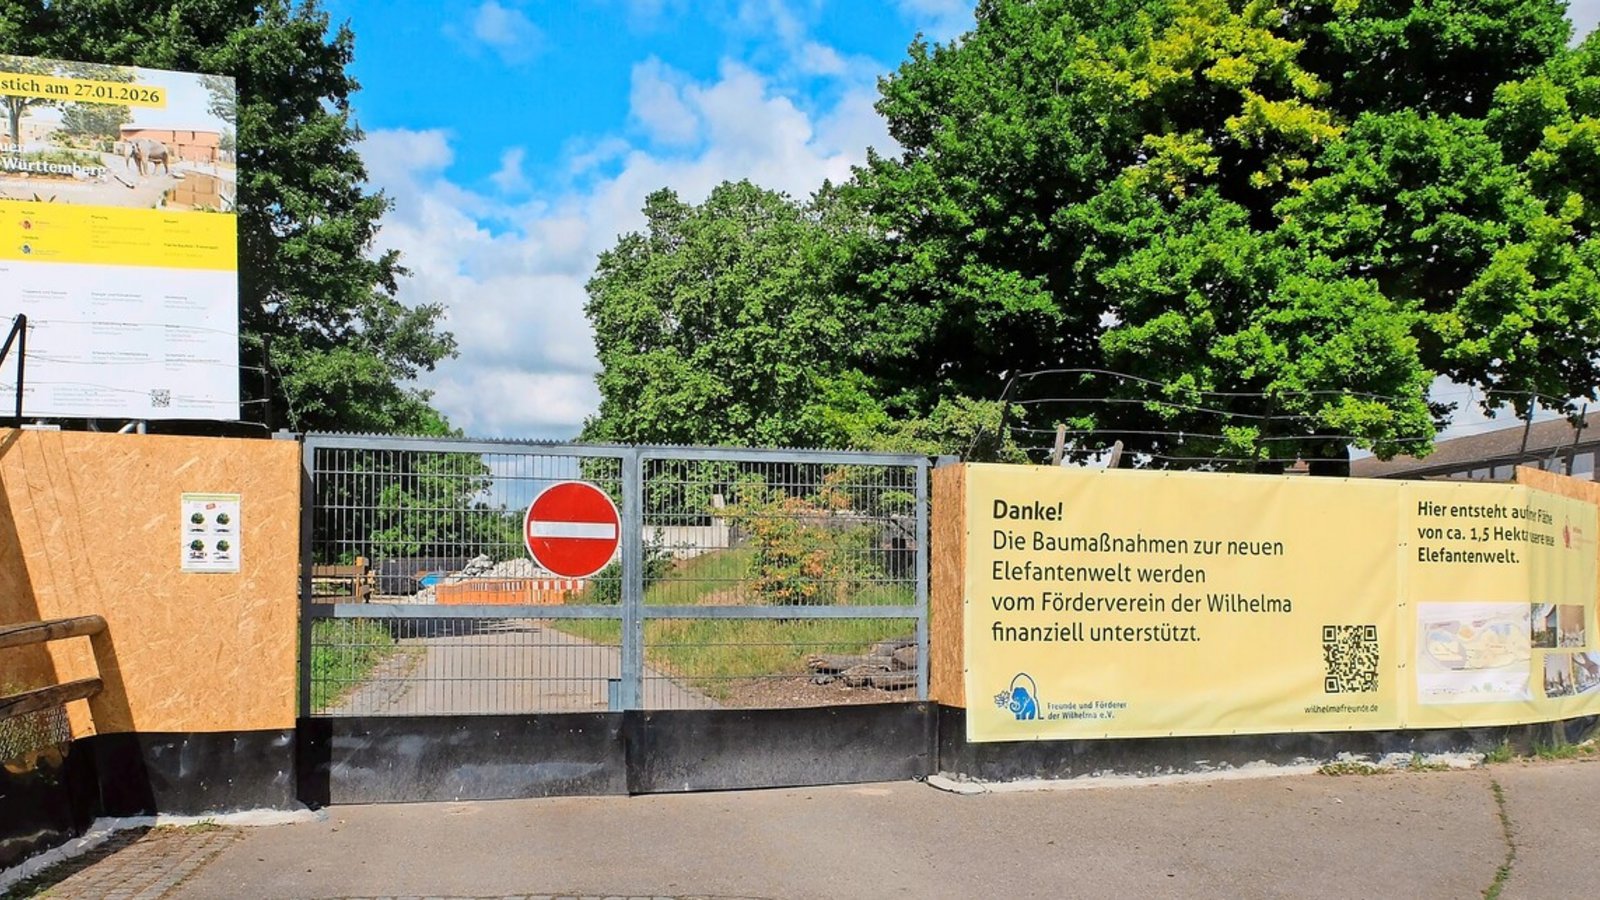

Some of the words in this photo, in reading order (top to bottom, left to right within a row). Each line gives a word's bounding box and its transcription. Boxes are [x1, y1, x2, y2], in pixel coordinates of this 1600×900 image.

[1, 78, 40, 92] stich
[45, 83, 69, 95] am
[74, 83, 160, 103] 27.01.2026
[993, 499, 1063, 521] Danke!
[1418, 500, 1448, 517] Hier
[1450, 503, 1508, 519] entsteht
[993, 530, 1026, 550] Die
[1033, 532, 1188, 554] Baumaßnahmen
[1193, 539, 1223, 555] zur
[1227, 540, 1285, 556] neuen
[1417, 527, 1443, 540] von
[1446, 528, 1466, 541] ca.
[1470, 527, 1490, 543] 1,5
[1418, 546, 1520, 564] Elefantenwelt.
[992, 561, 1132, 583] Elefantenwelt
[1137, 564, 1206, 584] werden
[991, 595, 1036, 612] vom
[1042, 591, 1166, 613] Förderverein
[1171, 593, 1202, 613] der
[1206, 593, 1293, 614] Wilhelma
[991, 621, 1084, 642] finanziell
[1090, 622, 1201, 643] unterstützt.
[1047, 702, 1077, 710] Freunde
[1079, 701, 1094, 710] und
[1095, 700, 1128, 710] Förderer
[1304, 703, 1379, 714] wilhelmafreunde.de
[1047, 712, 1060, 720] der
[1062, 711, 1098, 720] Wilhelma
[1099, 711, 1116, 719] e.V.
